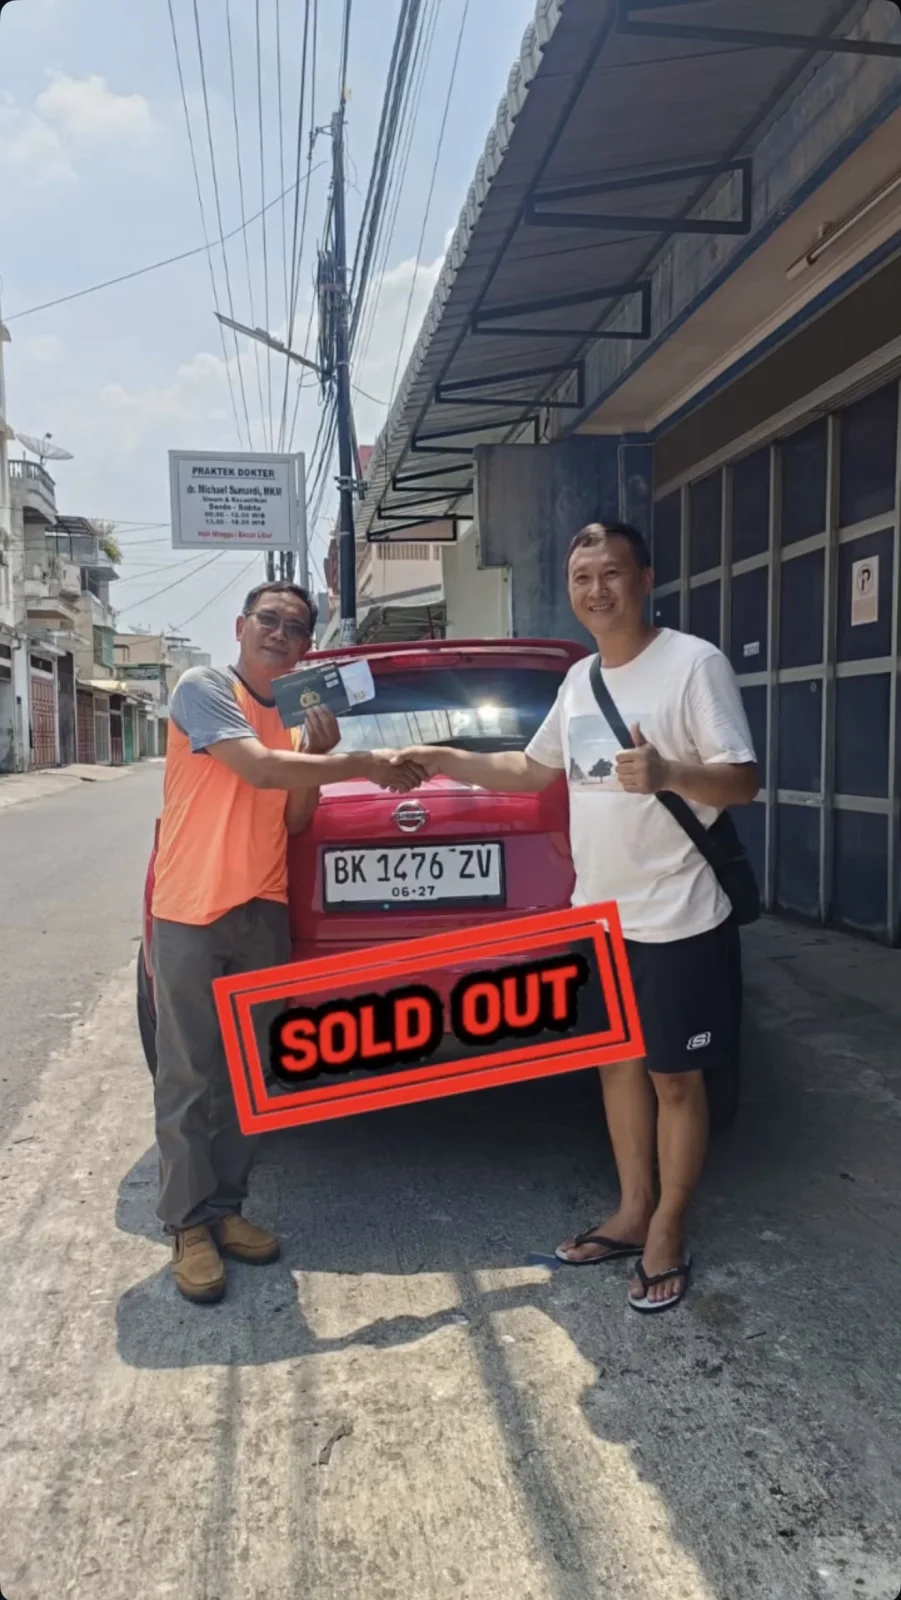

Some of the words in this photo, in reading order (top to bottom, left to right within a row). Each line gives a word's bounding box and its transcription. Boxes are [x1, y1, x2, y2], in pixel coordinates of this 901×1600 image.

[192, 467, 236, 477] PRAKTEK
[238, 468, 275, 478] DOKTER
[198, 485, 228, 494] Michael
[229, 486, 262, 496] Sumardi,
[334, 854, 367, 884] BK
[376, 851, 444, 882] 1476
[459, 848, 492, 879] ZV
